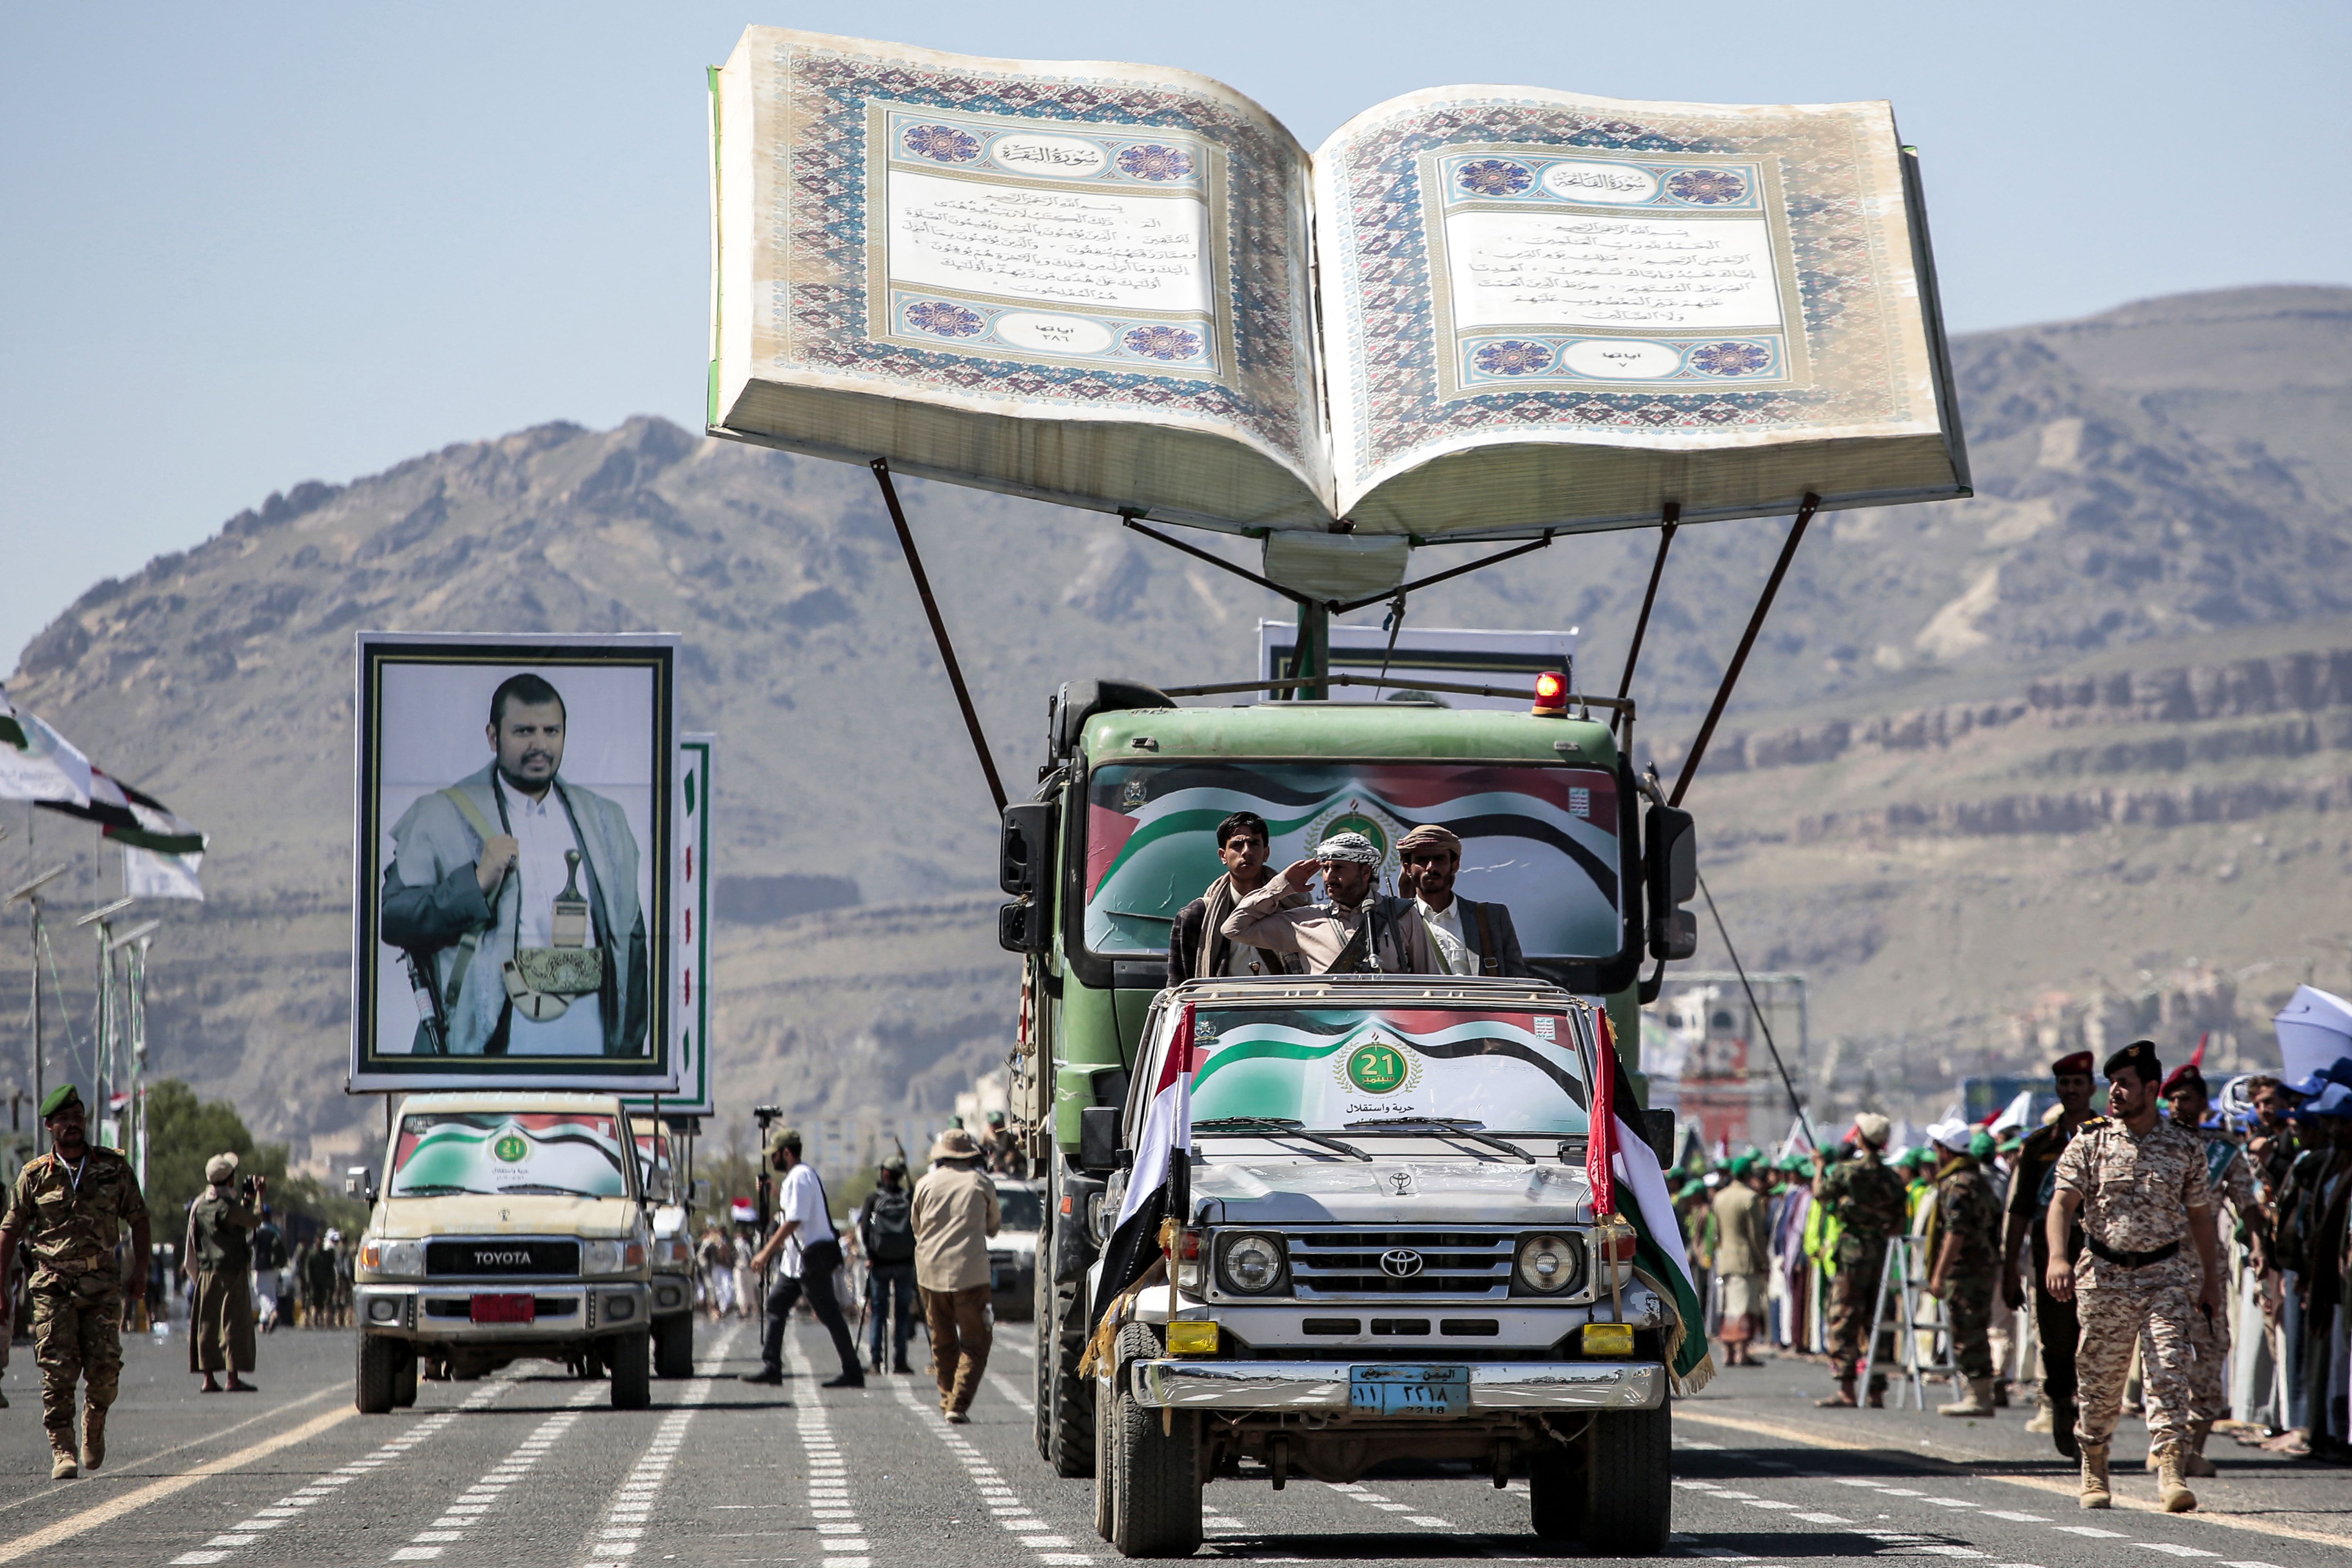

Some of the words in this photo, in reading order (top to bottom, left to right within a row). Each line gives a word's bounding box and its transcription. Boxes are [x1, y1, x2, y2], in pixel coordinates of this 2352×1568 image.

[1361, 1053, 1394, 1075] 21
[1363, 1075, 1394, 1084] سبتمبر
[1346, 1103, 1390, 1113] واستقلال
[1392, 1103, 1414, 1113] حرية
[503, 1140, 519, 1153] 21
[474, 1252, 531, 1264] TOYOTA
[1423, 1368, 1455, 1381] اليمن
